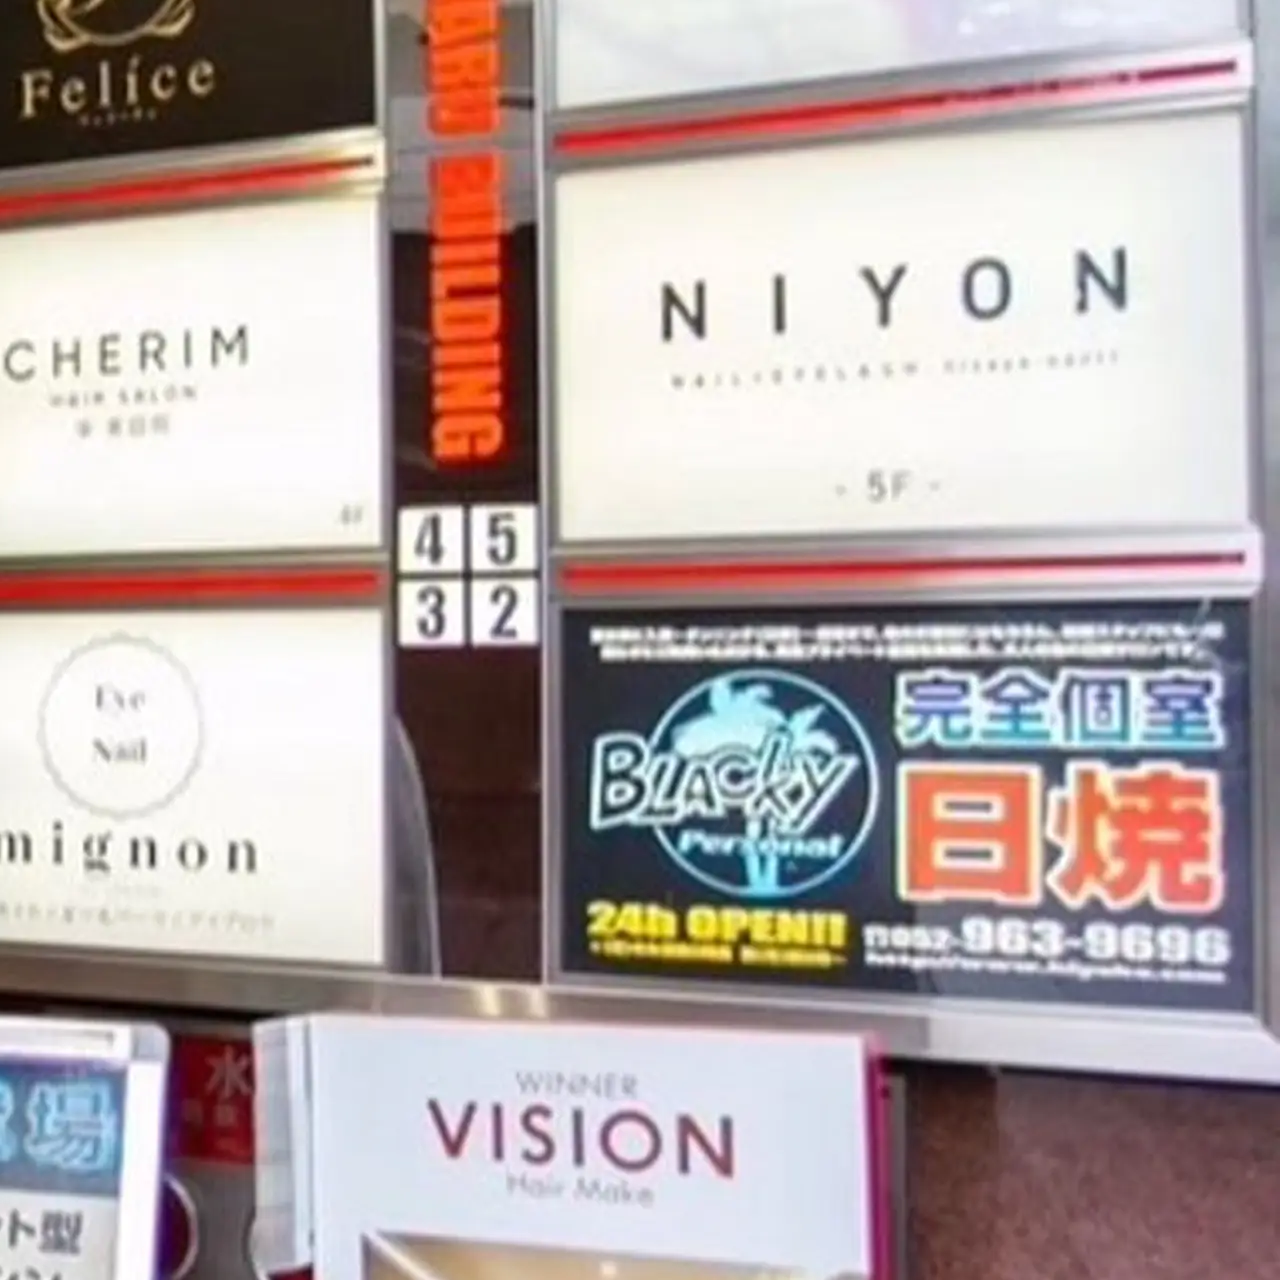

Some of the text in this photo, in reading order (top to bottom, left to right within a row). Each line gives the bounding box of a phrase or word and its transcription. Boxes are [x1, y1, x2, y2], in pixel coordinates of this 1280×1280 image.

[660, 246, 1128, 343] NIYON
[3, 325, 250, 383] CHERIM
[413, 514, 518, 565] 4 5
[417, 586, 519, 639] 3 2
[894, 670, 1225, 749] 完全個室
[92, 736, 148, 765] Nail
[897, 762, 1224, 912] 日焼
[515, 1070, 638, 1099] WINNER
[427, 1097, 735, 1179] VISION
[506, 1171, 654, 1208] Hair Make
